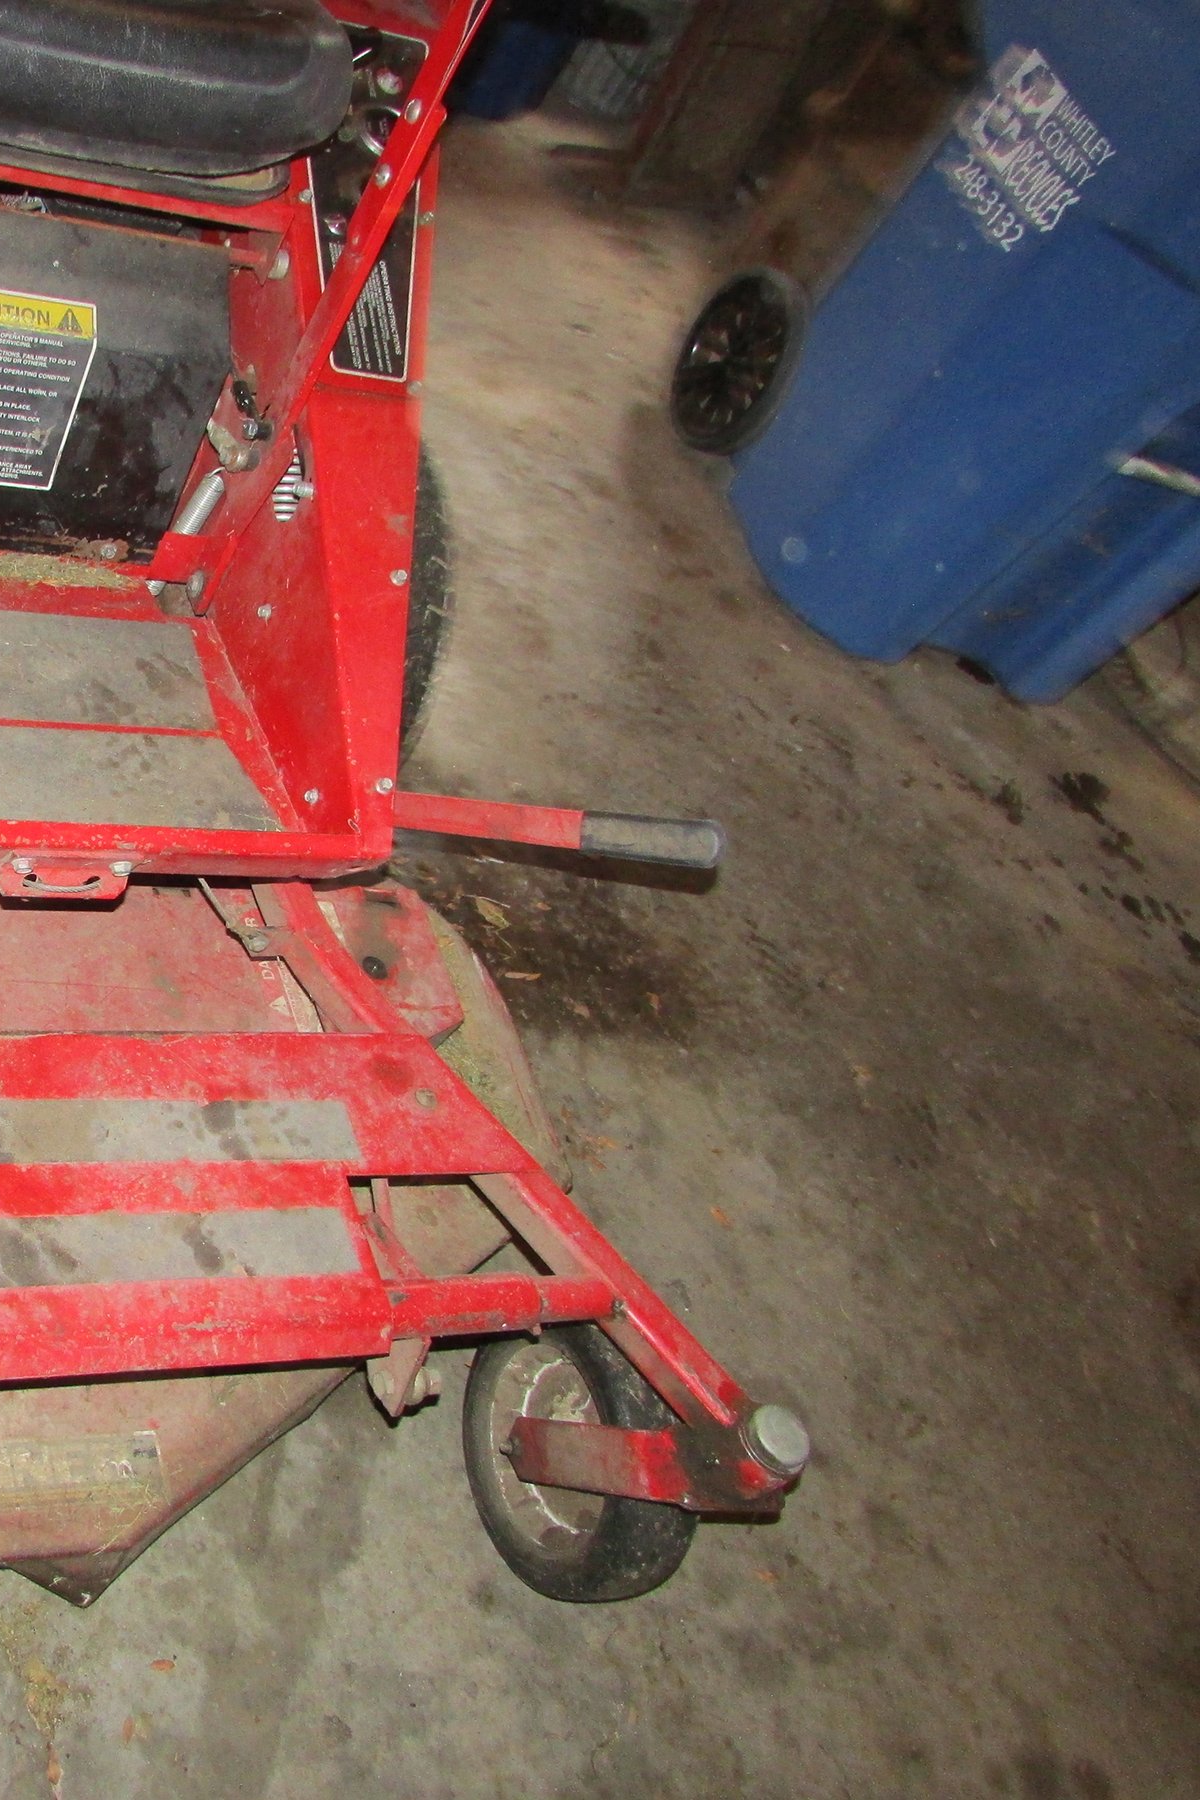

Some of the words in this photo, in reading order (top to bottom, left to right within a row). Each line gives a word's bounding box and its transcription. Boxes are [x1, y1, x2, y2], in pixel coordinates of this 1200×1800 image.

[1055, 95, 1117, 166] WHITLEY
[1039, 120, 1096, 188] COUNTY
[39, 338, 63, 346] MANUAL
[0, 355, 12, 363] YOU
[23, 353, 47, 361] FAILURE
[3, 368, 36, 377] OPERATING
[38, 372, 70, 381] CONDITION
[8, 413, 39, 422] INTERLOCK
